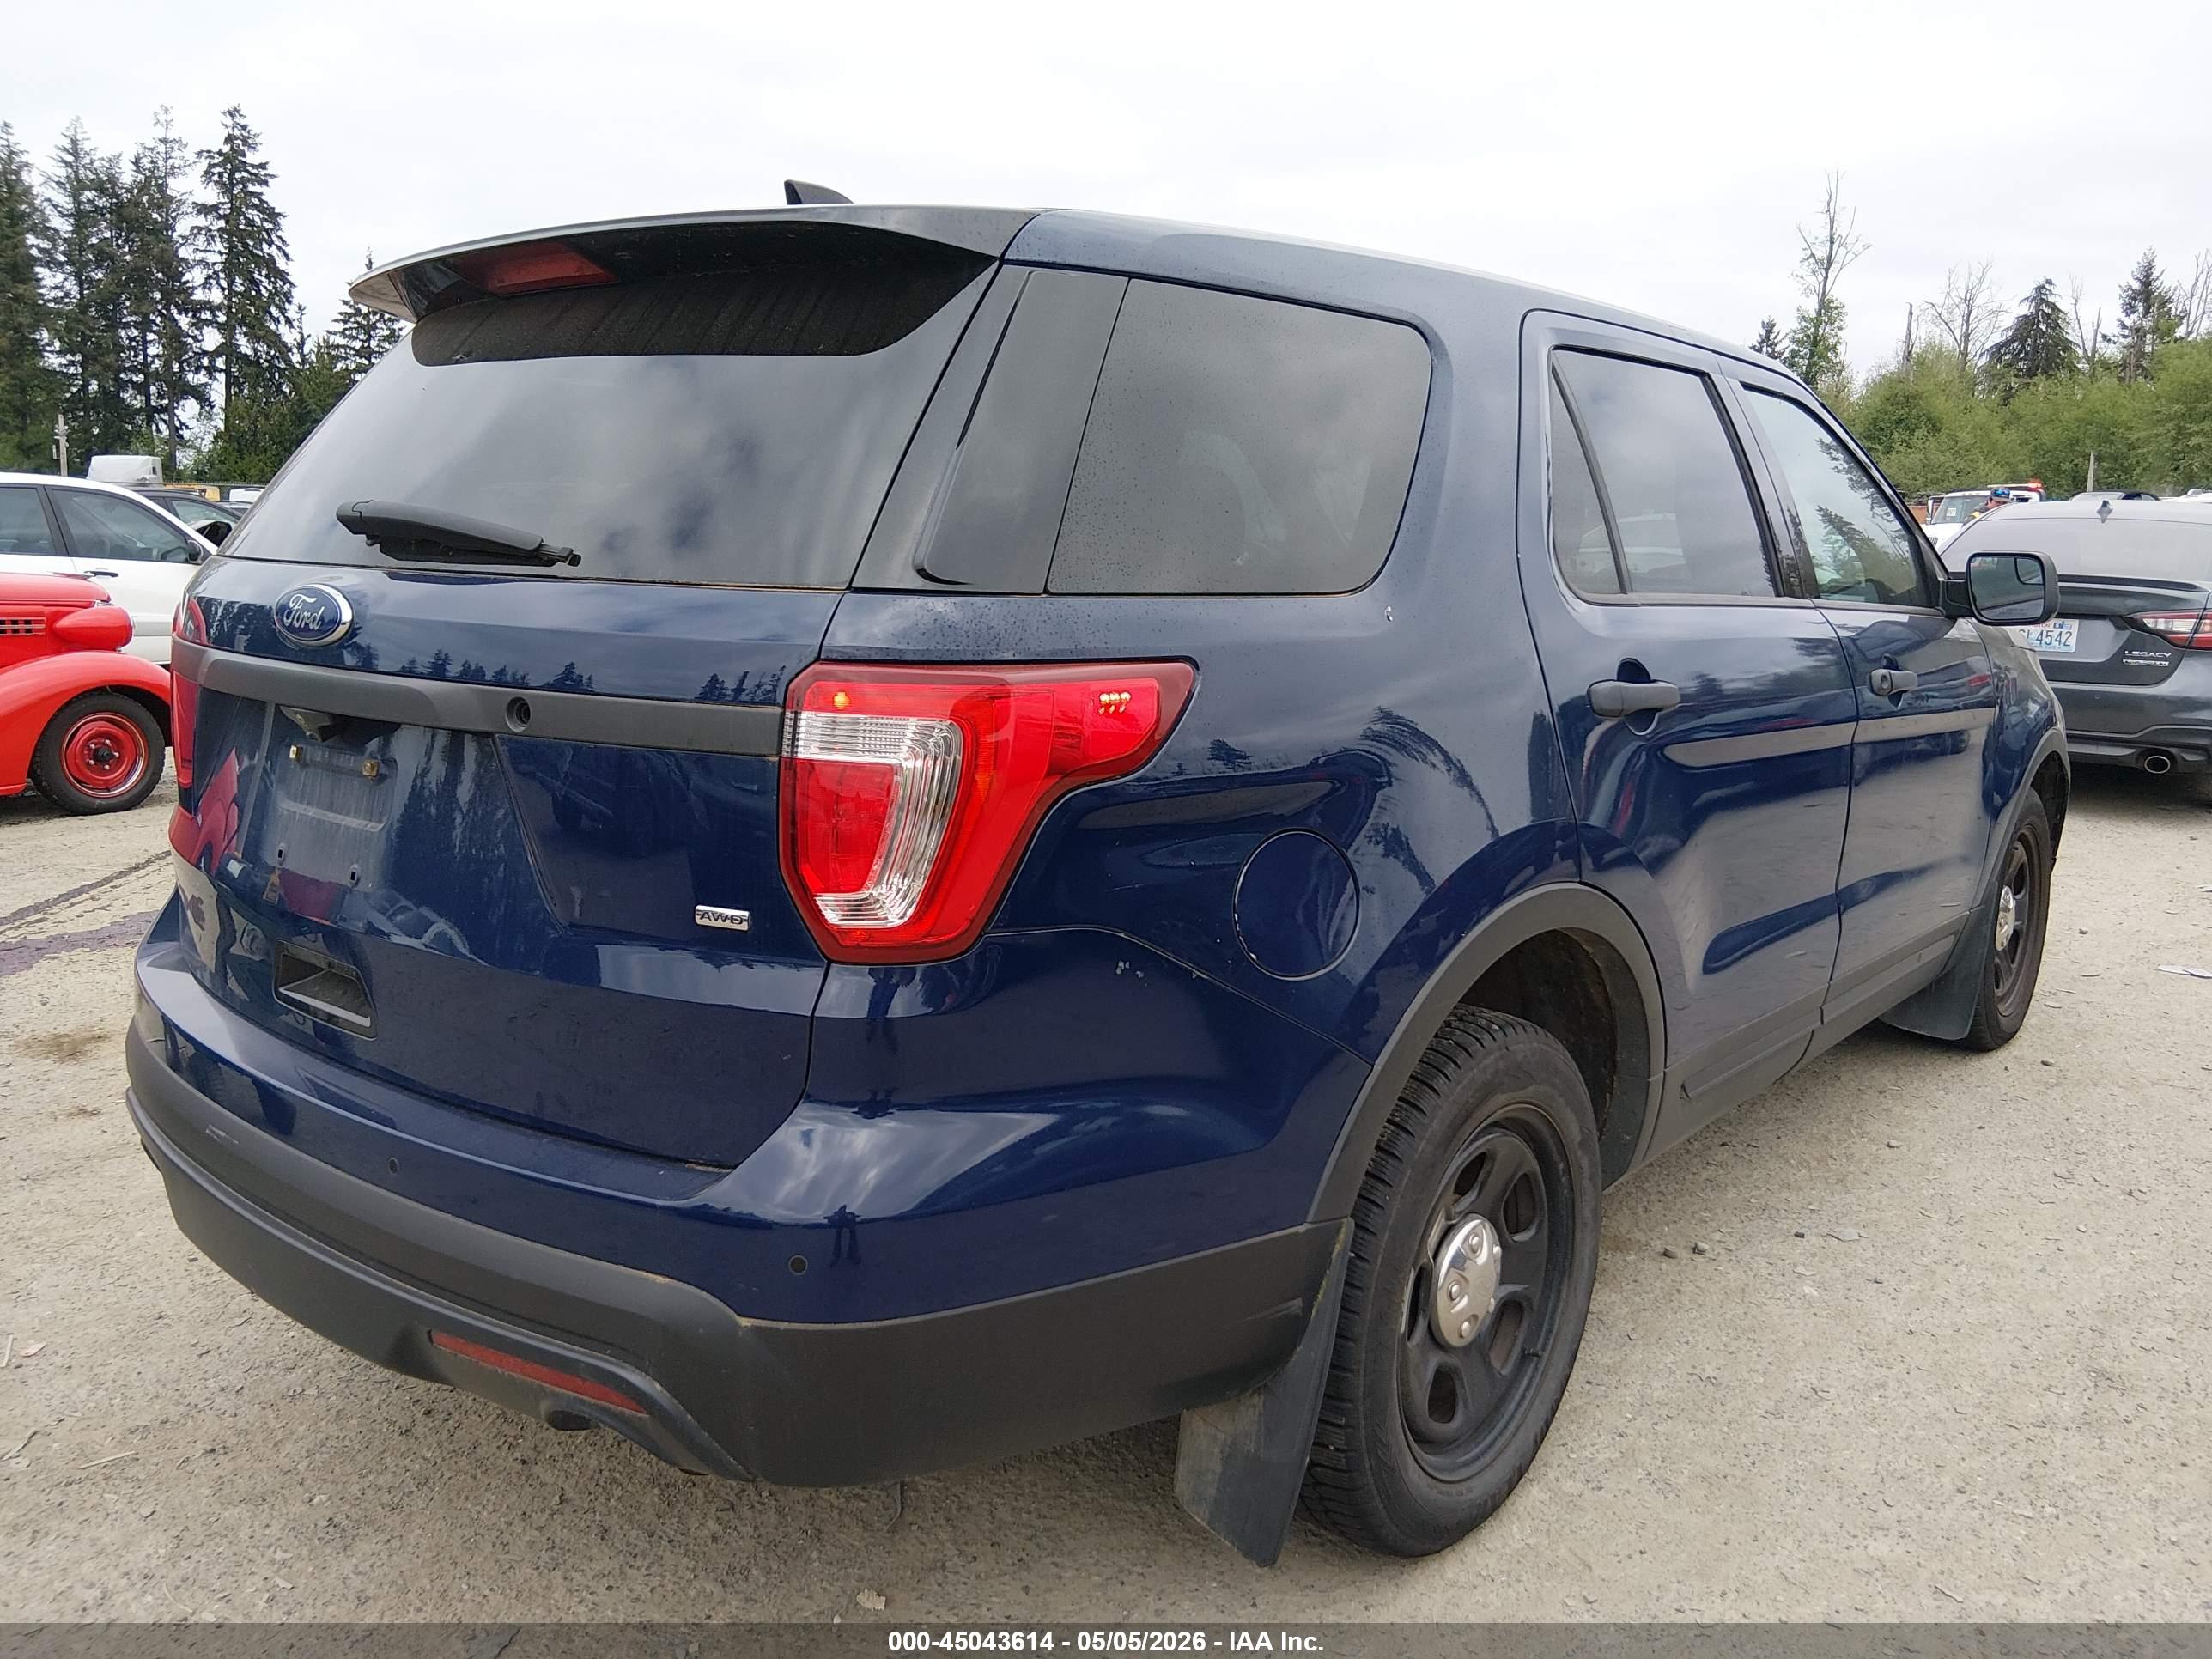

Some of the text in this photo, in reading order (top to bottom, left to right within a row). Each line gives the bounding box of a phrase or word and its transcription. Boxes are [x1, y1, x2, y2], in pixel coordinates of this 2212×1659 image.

[283, 593, 325, 630] Ford
[2019, 629, 2073, 647] 4542
[699, 911, 744, 925] AWD
